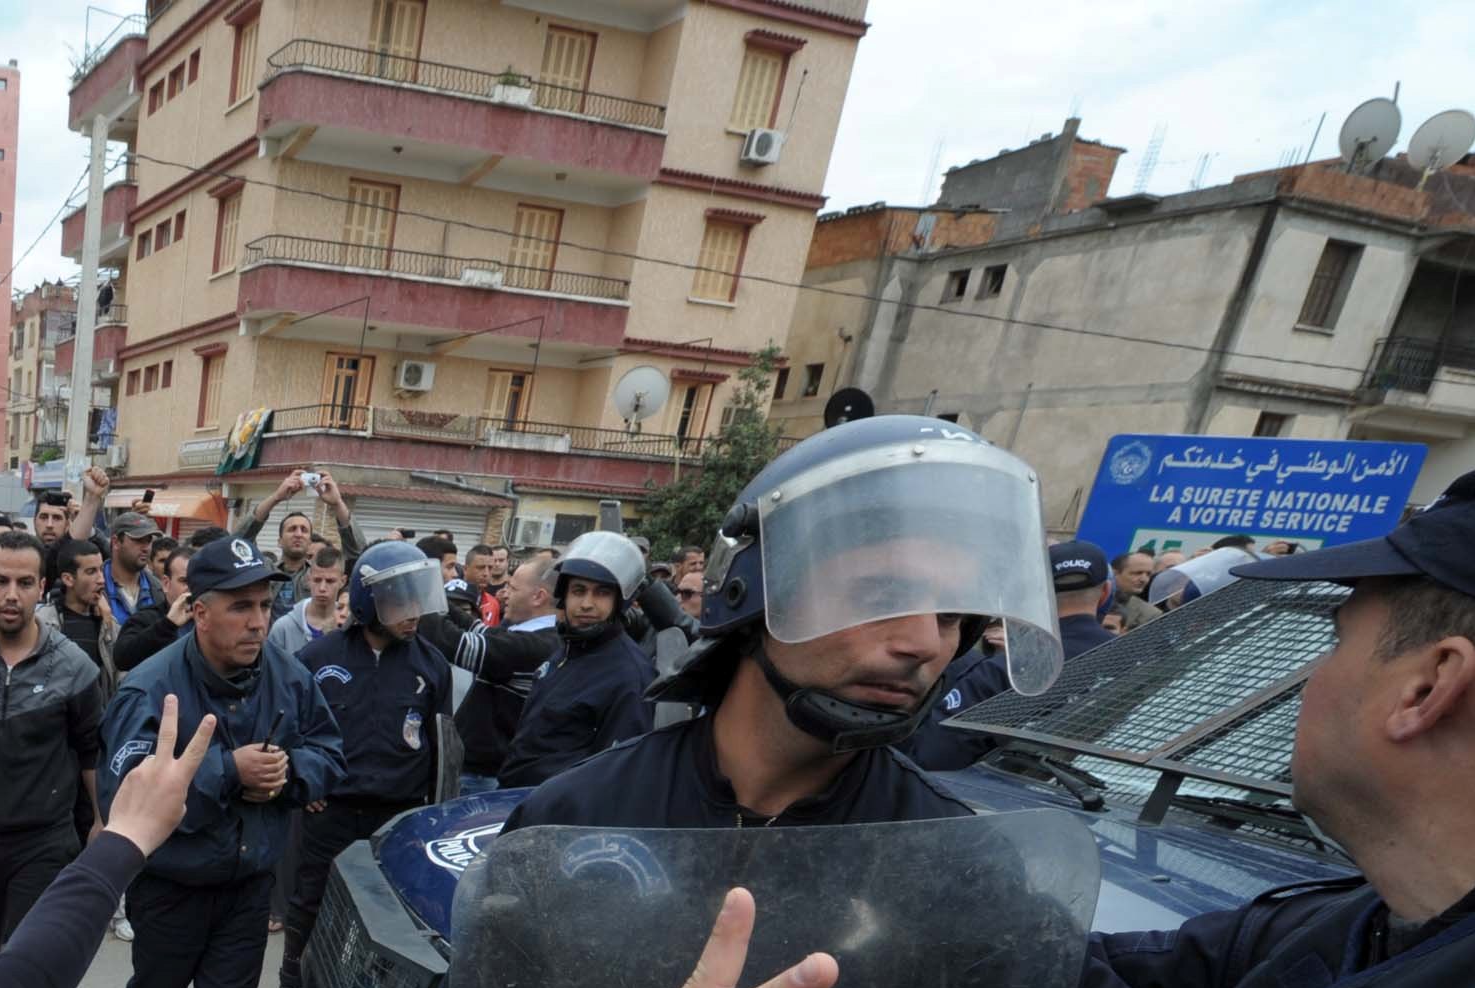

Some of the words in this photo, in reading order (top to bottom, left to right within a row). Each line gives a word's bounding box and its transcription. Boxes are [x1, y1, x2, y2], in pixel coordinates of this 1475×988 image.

[1158, 446, 1245, 475] خدمتكم
[1245, 450, 1278, 483] في
[1276, 449, 1354, 484] الوطني
[1351, 450, 1409, 482] الأمن
[1149, 485, 1173, 503] LA
[1179, 486, 1263, 507] SURETE
[1265, 490, 1389, 514] NATIONALE
[1167, 506, 1182, 523] A
[1188, 507, 1253, 528] VOTRE
[1259, 510, 1354, 533] SERVICE
[1055, 559, 1092, 571] POLICE
